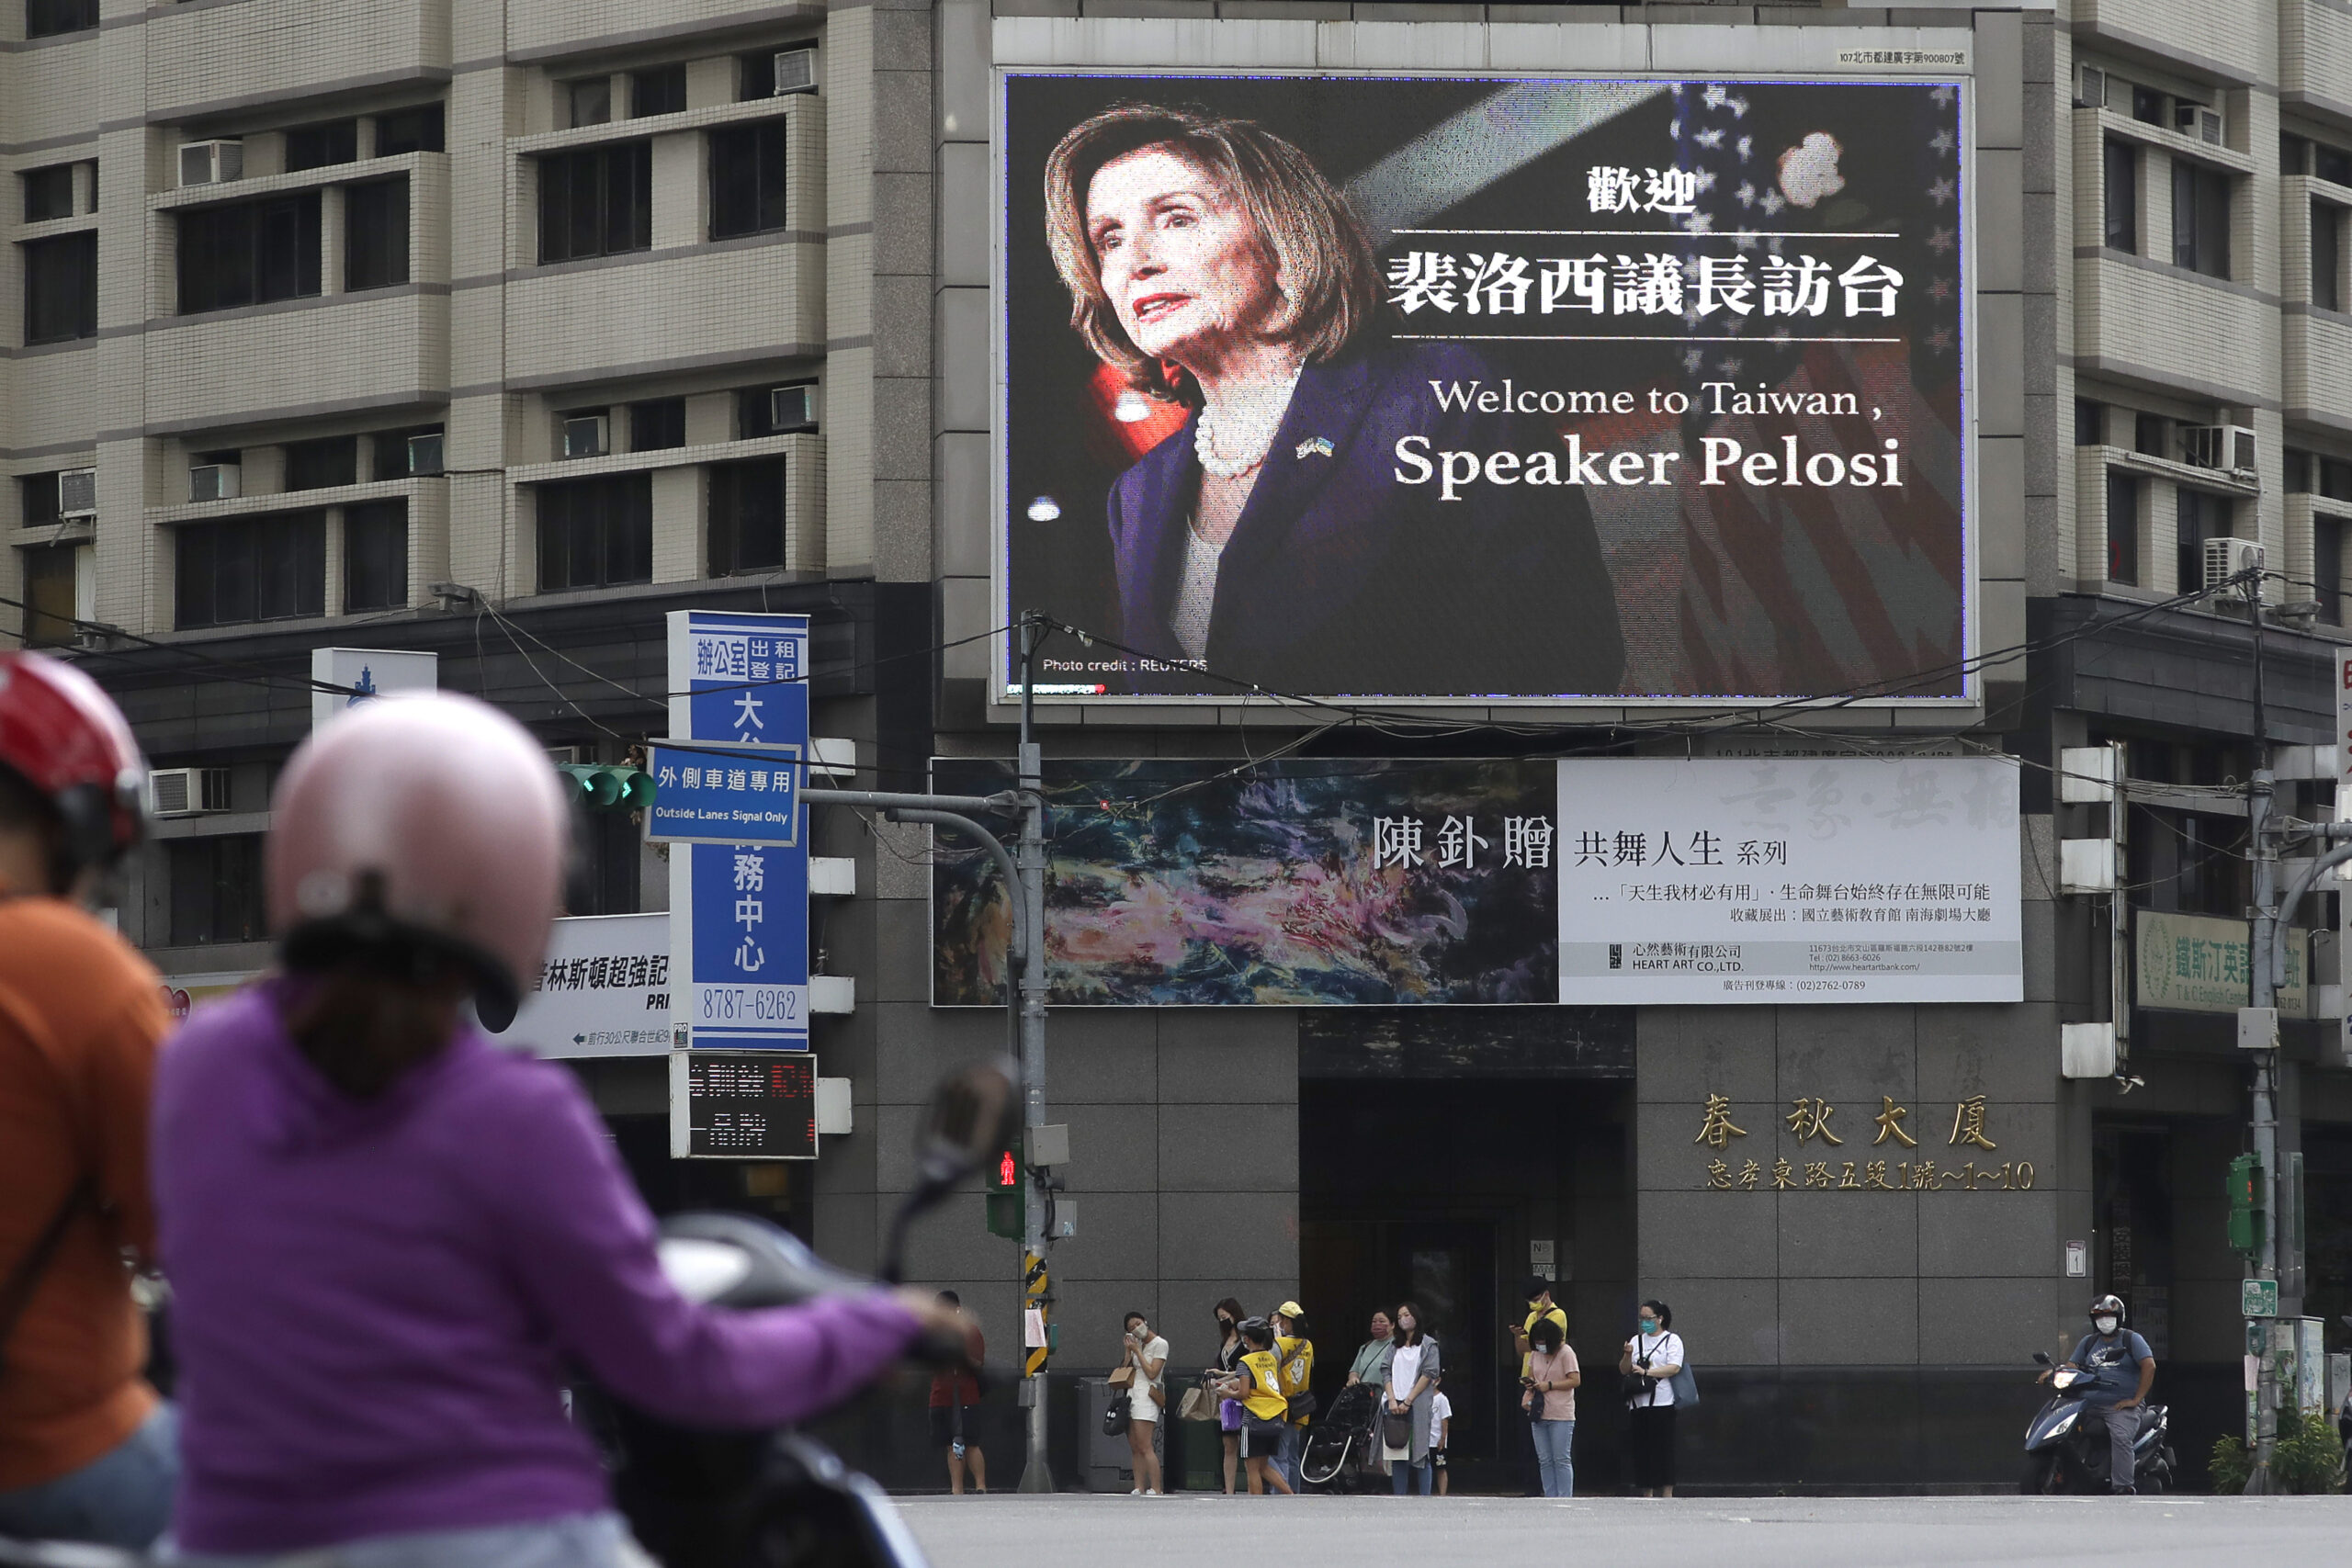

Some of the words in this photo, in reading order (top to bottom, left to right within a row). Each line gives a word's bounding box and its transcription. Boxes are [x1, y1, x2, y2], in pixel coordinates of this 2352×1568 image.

[1586, 166, 1698, 214] 歡迎
[1385, 251, 1905, 318] 裴洛西議長訪台
[1428, 378, 1634, 414] Welcome
[1649, 384, 1690, 414] to
[1393, 434, 1680, 502] Speaker
[1699, 434, 1904, 488] Pelosi
[697, 638, 746, 676] 辦公室
[751, 639, 796, 659] 出租
[750, 660, 796, 680] 登記
[1043, 659, 1083, 671] Photo
[1087, 659, 1127, 671] credit
[1140, 659, 1208, 672] REUTERS
[658, 766, 790, 793] 外側車道專用
[655, 807, 695, 818] Outside
[698, 808, 729, 820] Lanes
[732, 810, 763, 824] Signal
[764, 811, 787, 825] Only
[733, 692, 765, 973] 大務中心
[1574, 830, 1724, 867] 共舞人生
[1736, 840, 1787, 865] 系列
[1905, 908, 1992, 923] 南海劇場大廳
[1633, 942, 1741, 958] 心然藝術有限公司
[1826, 953, 1840, 962] (02)
[1841, 953, 1881, 962] 8663-6026
[532, 954, 670, 992] 普林斯頓超強記
[1633, 960, 1669, 970] HEART
[1673, 960, 1695, 969] ART
[1697, 961, 1744, 973] CO.,LTD.
[1809, 963, 1920, 972] http://www.heartartbank.com/
[646, 993, 670, 1010] PRI
[704, 988, 796, 1020] 8787-6262
[588, 1029, 670, 1045] 前行30公尺聯合世紀9
